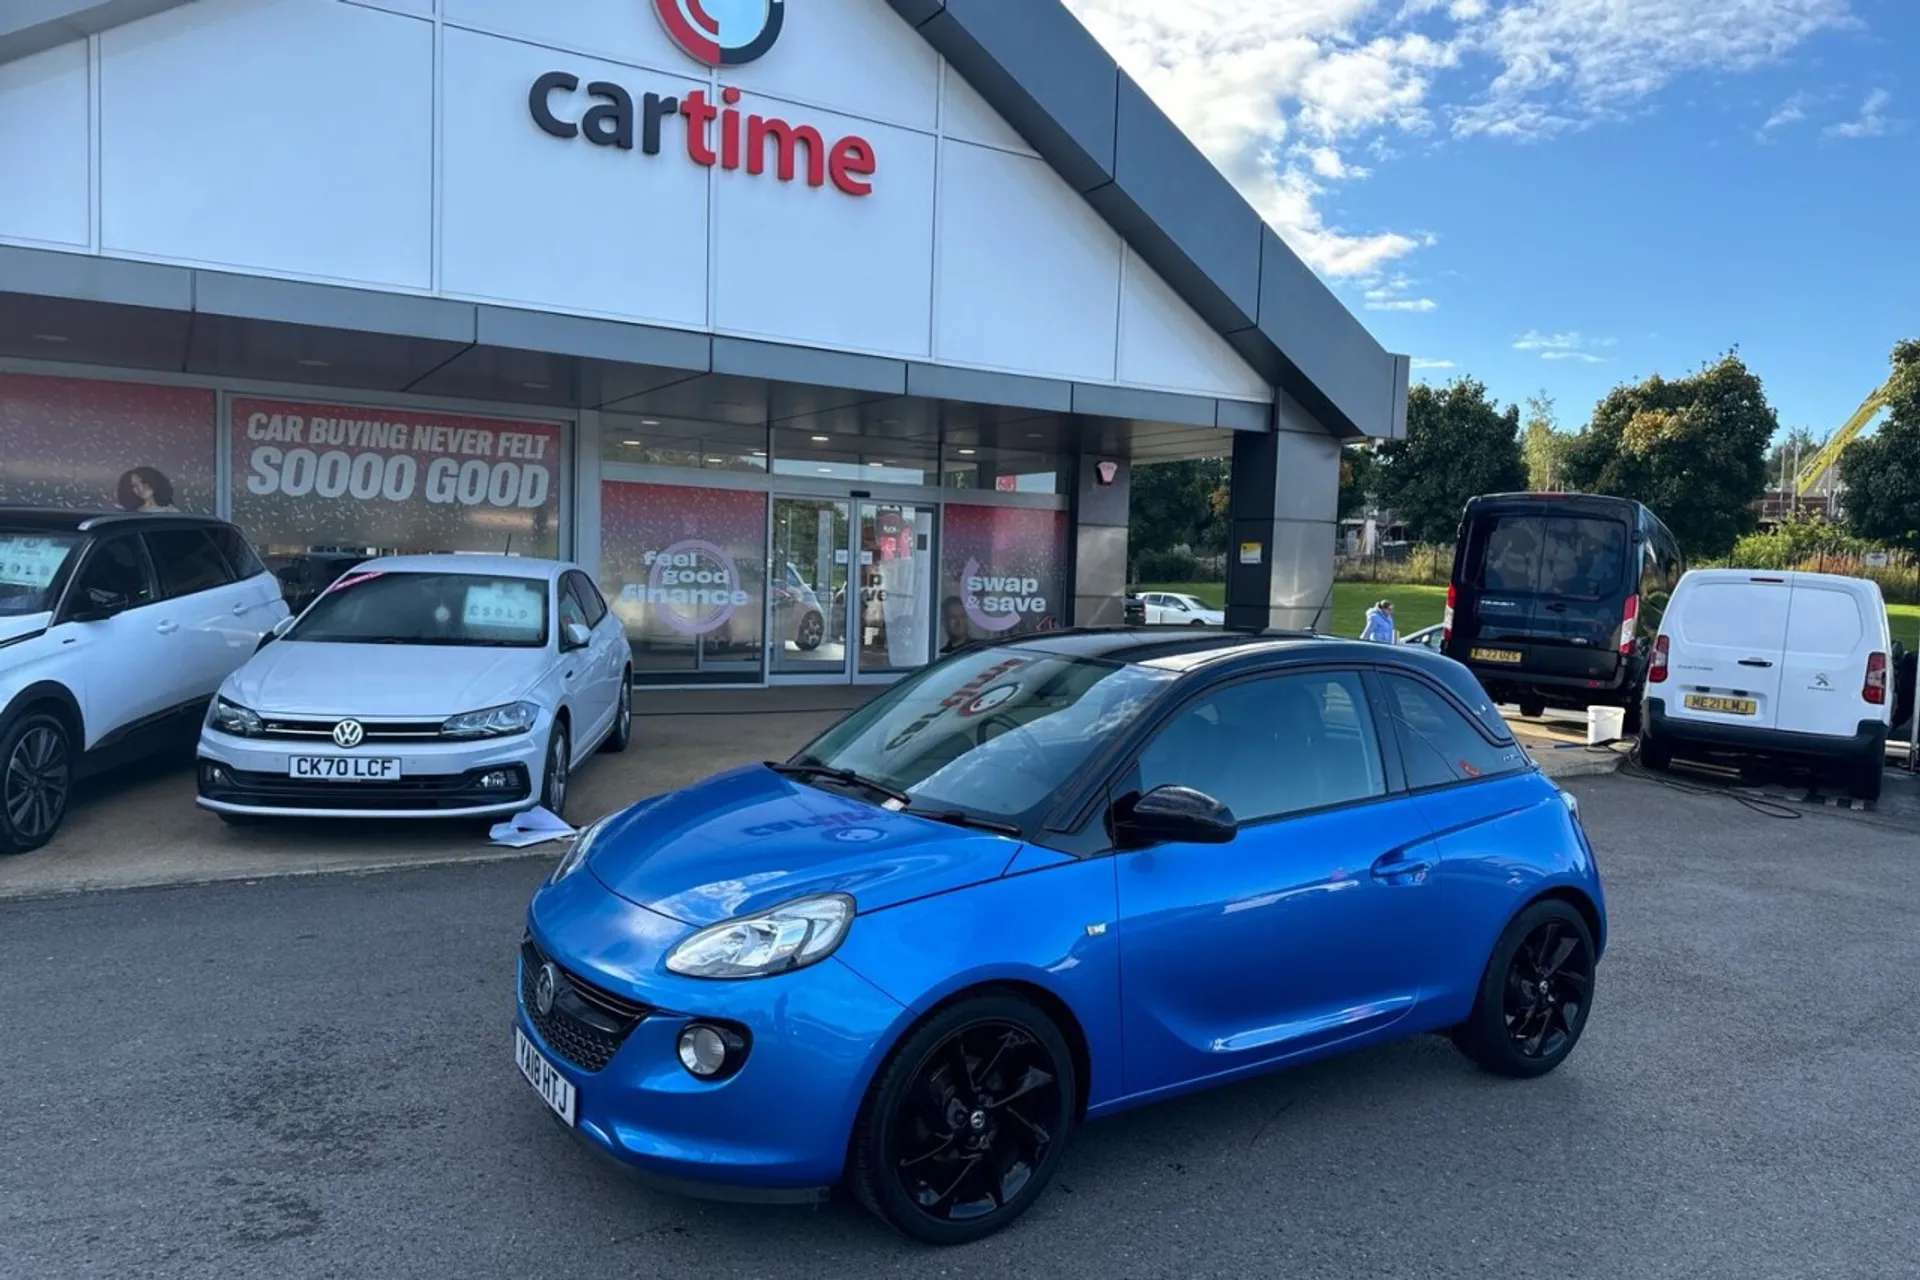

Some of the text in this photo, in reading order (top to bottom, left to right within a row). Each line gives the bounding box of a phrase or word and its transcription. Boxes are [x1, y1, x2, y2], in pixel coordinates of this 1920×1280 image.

[528, 71, 876, 196] cartime
[247, 412, 550, 460] CAR BUYING NEVER FELT
[247, 446, 550, 508] SOOOO GOOD
[643, 551, 697, 567] feel
[661, 568, 729, 585] good
[967, 576, 1039, 596] swap
[621, 583, 749, 606] finance
[967, 595, 1047, 613] & save
[297, 758, 393, 777] CK70 LCF
[519, 1035, 568, 1115] YA18 HTJ
